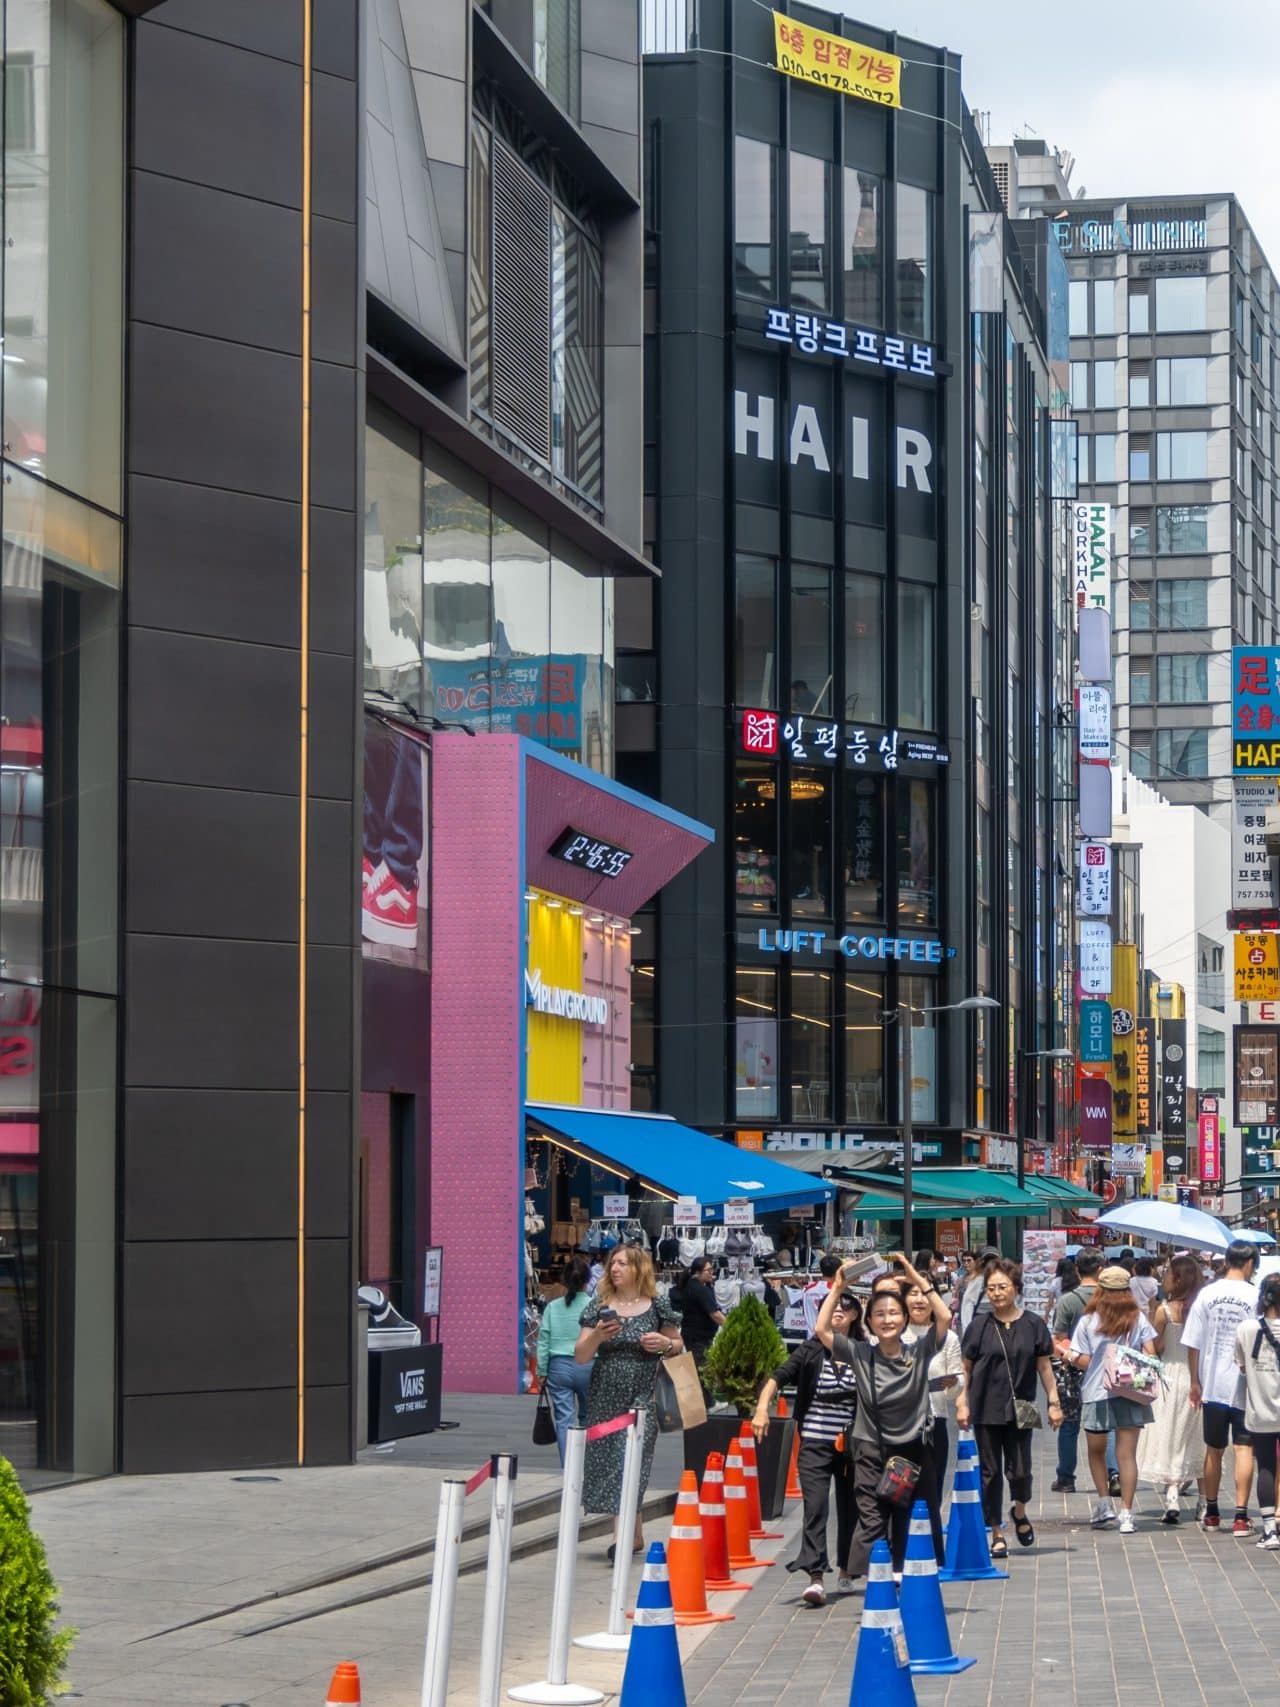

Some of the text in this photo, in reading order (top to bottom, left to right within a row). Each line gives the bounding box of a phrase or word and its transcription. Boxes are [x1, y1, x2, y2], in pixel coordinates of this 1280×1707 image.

[780, 23, 895, 84] 6층 입점 가능
[735, 390, 933, 494] HAIR
[1076, 506, 1088, 592] GURKHA
[1090, 506, 1106, 583] HALAL
[1237, 656, 1270, 695] 足
[784, 716, 899, 770] 일편등심
[1244, 816, 1266, 828] 증명
[1238, 870, 1273, 882] 프로필
[1244, 852, 1267, 864] 비자
[758, 928, 826, 955] LUFT
[839, 935, 942, 964] COFFEE
[1090, 980, 1101, 988] 2F
[1235, 967, 1279, 981] 사주카페
[1137, 1043, 1149, 1127] SUPER PET
[400, 1369, 425, 1398] VANS
